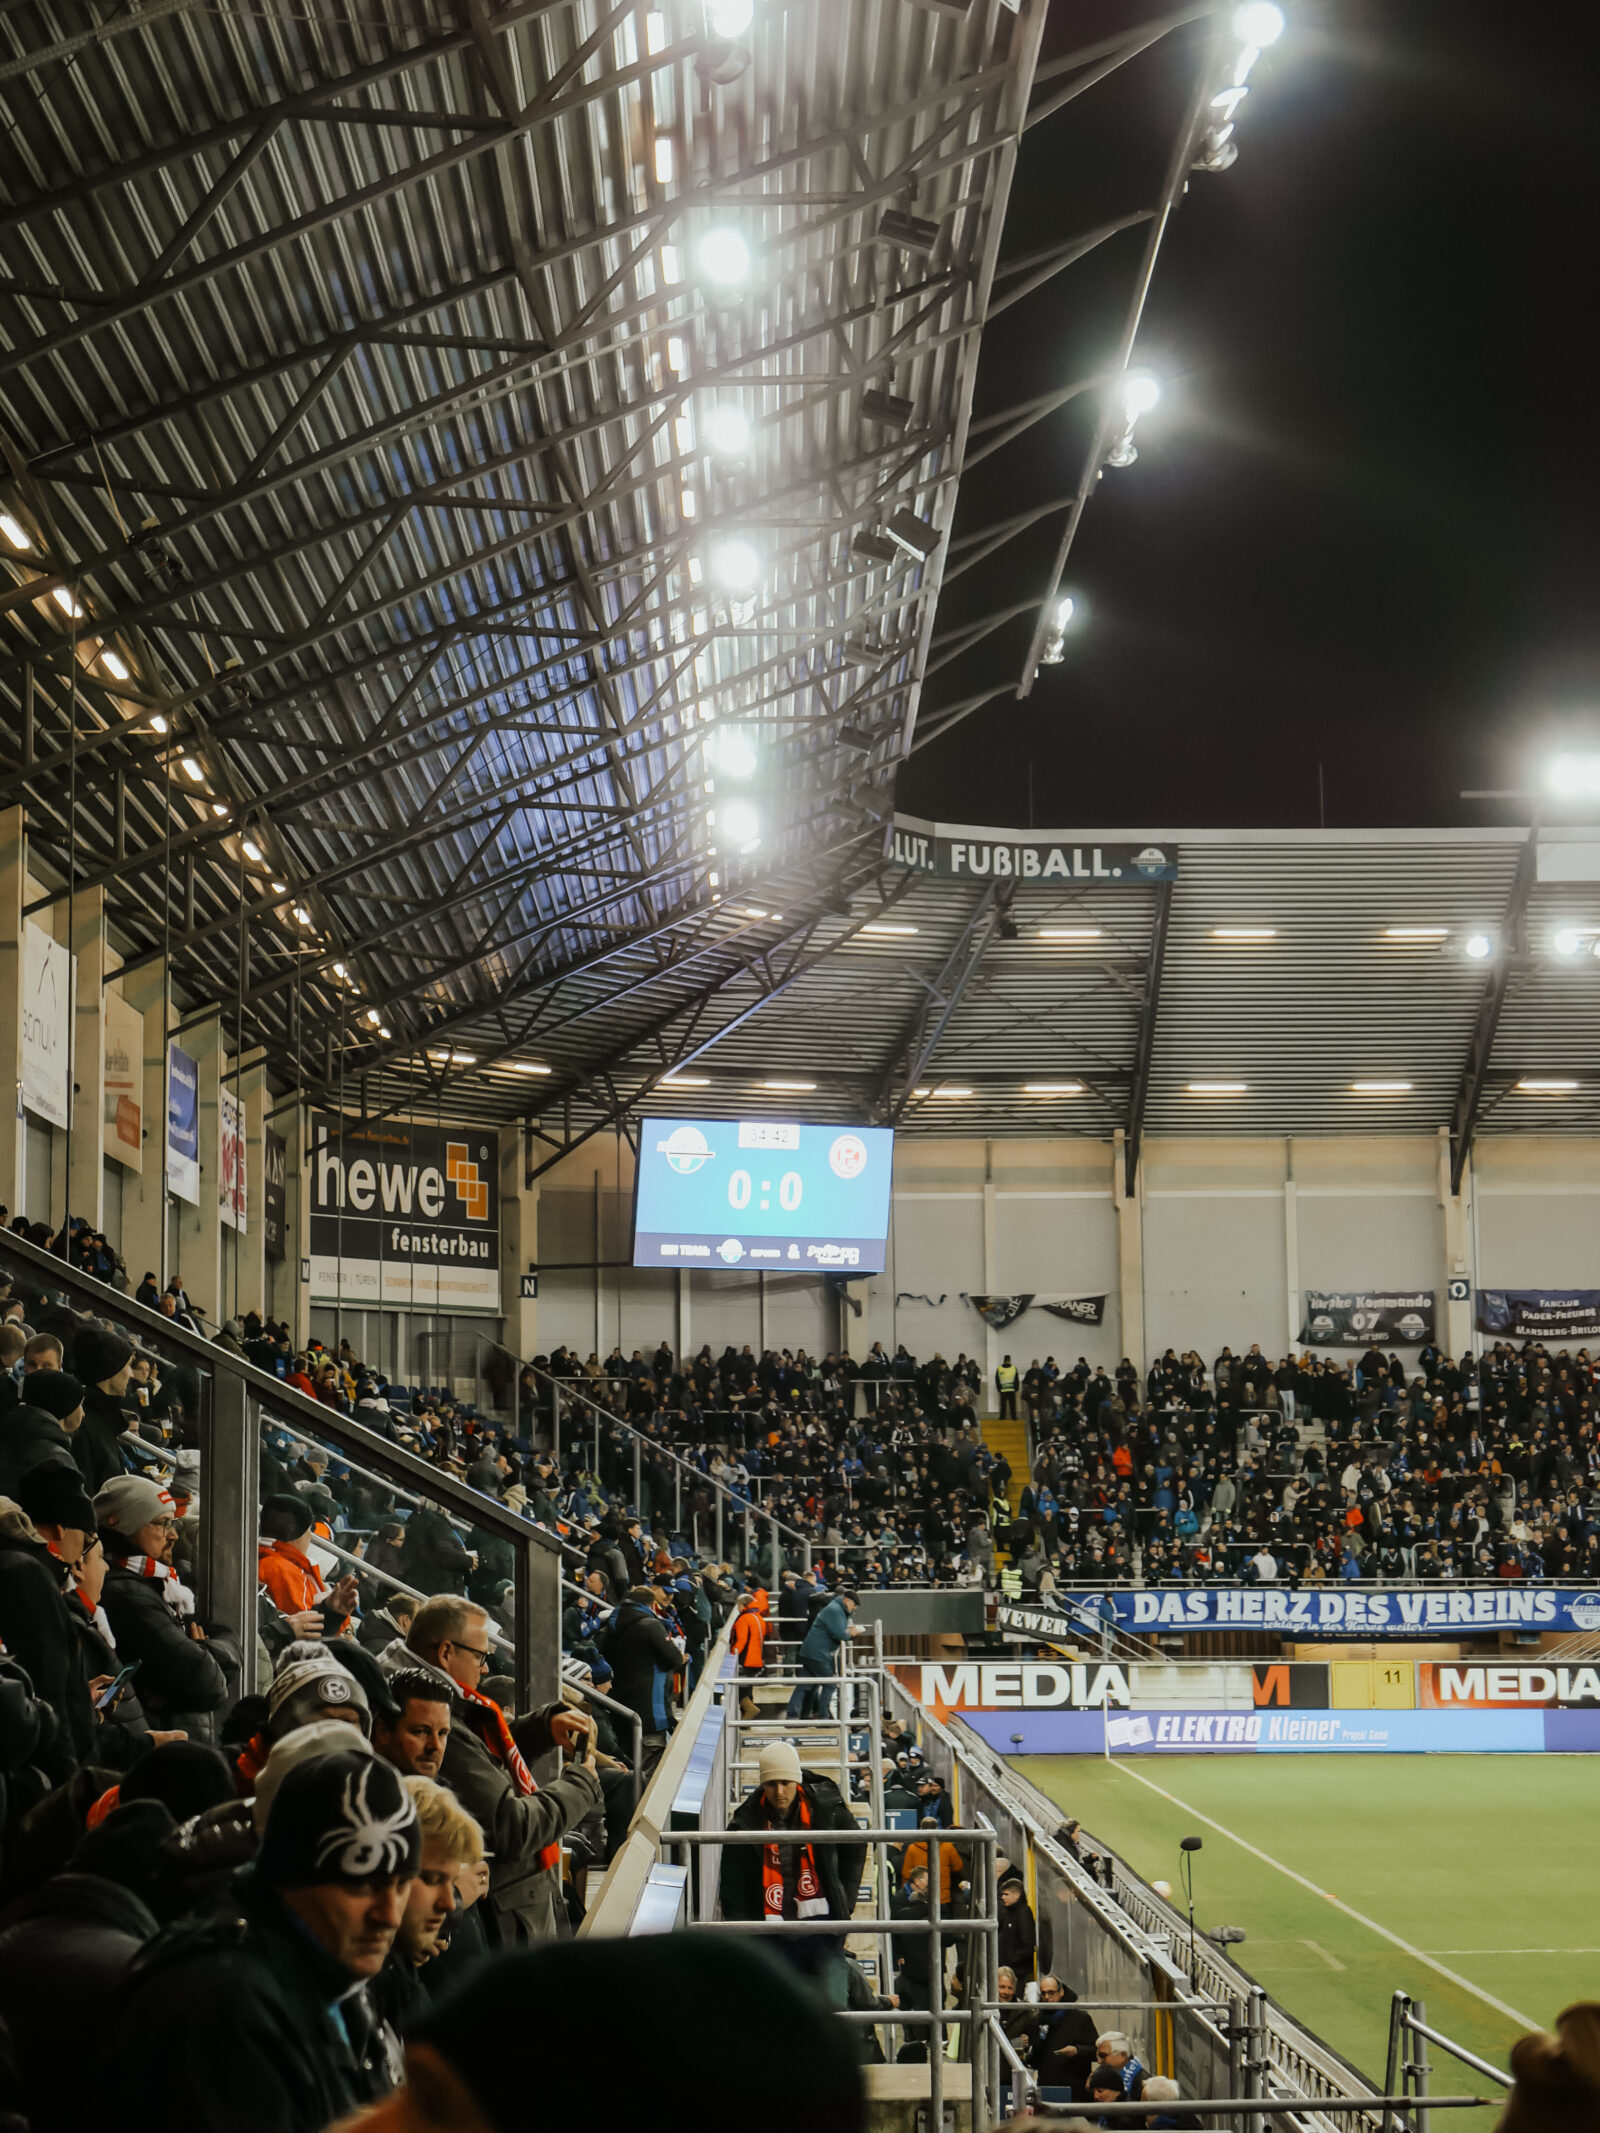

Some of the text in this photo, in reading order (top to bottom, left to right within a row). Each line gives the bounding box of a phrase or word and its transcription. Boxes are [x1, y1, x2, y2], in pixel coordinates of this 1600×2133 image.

[318, 1126, 445, 1217] hewe
[392, 1227, 489, 1258] fensterbau
[319, 1271, 348, 1284] FENSTER
[524, 1279, 535, 1296] N
[1450, 1282, 1467, 1298] O
[1352, 1313, 1381, 1331] 07
[1134, 1591, 1557, 1624] DAS HERZ DES VEREINS
[921, 1665, 1130, 1706] MEDIA
[1384, 1670, 1401, 1684] 11
[1439, 1667, 1600, 1701] MEDIA
[1156, 1716, 1262, 1742] ELEKTRO
[1268, 1716, 1340, 1742] Kleiner
[853, 1740, 861, 1750] J
